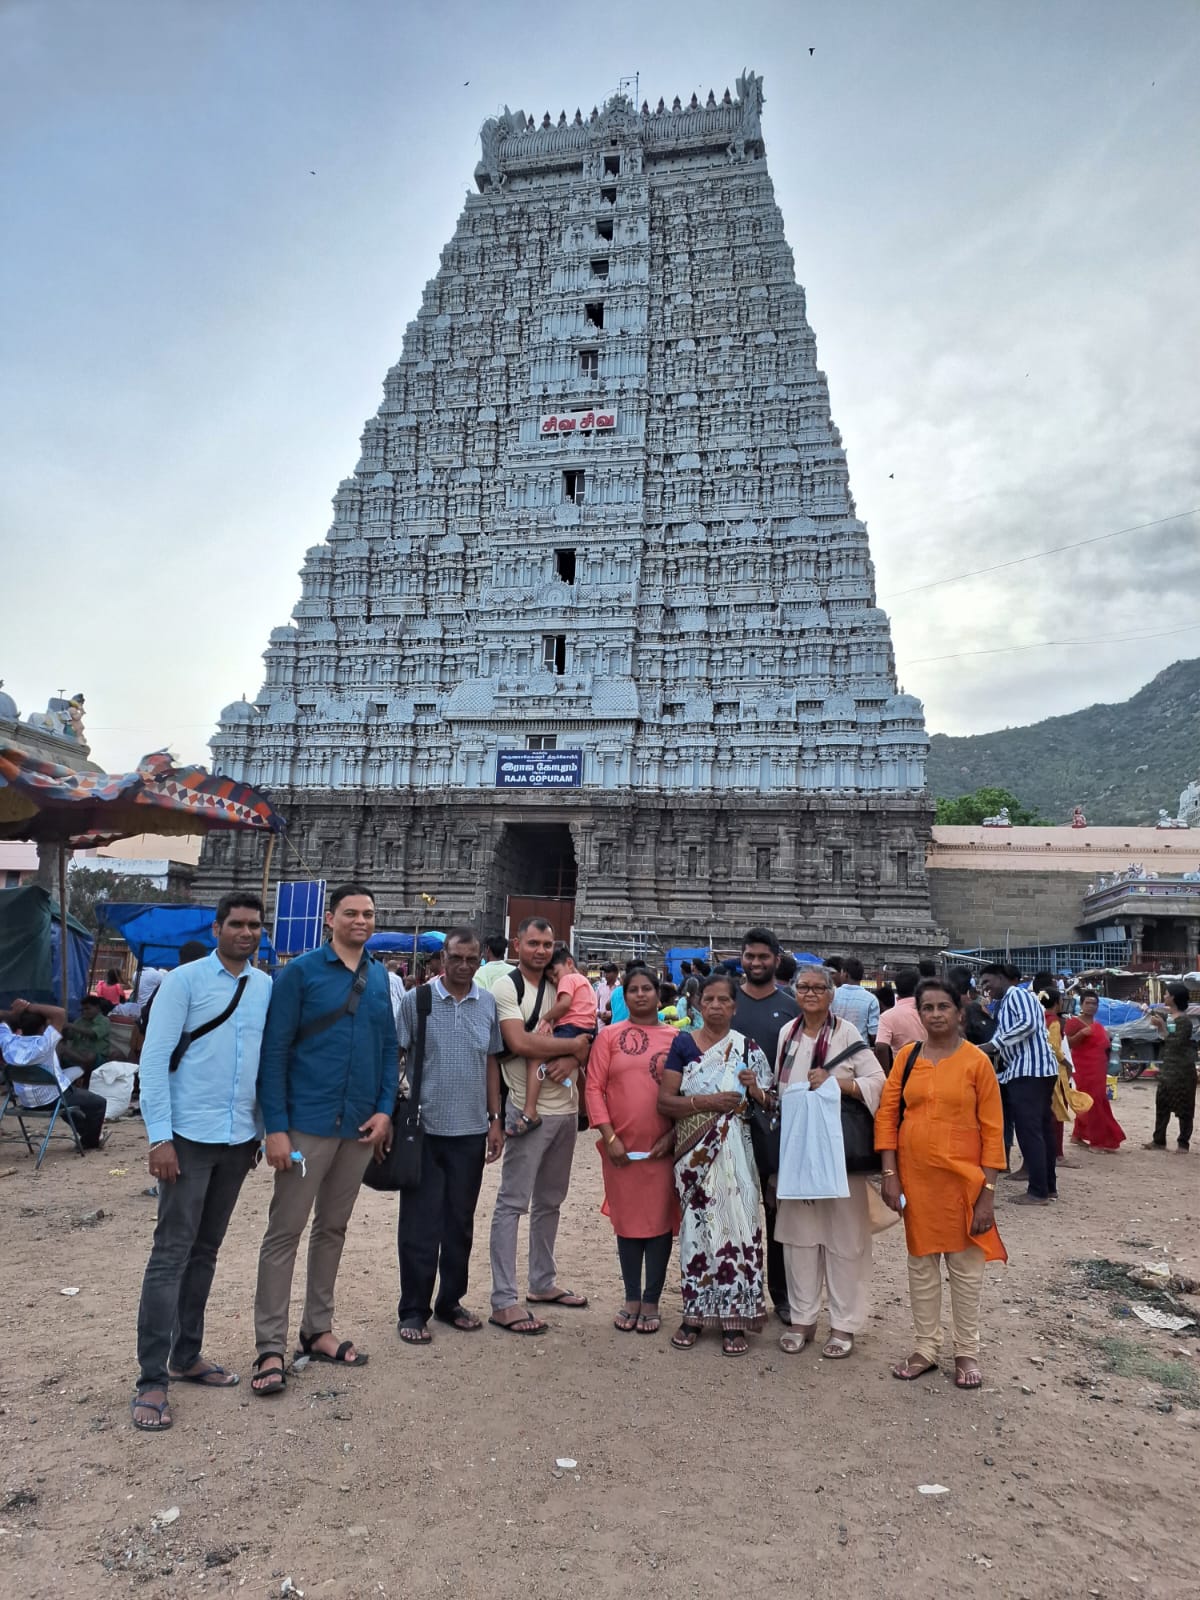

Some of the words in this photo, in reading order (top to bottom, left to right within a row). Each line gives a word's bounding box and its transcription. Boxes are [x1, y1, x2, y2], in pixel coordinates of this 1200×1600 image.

[542, 416, 576, 432] சிவ
[580, 412, 614, 428] சிவ
[536, 762, 577, 773] கோபுரம்
